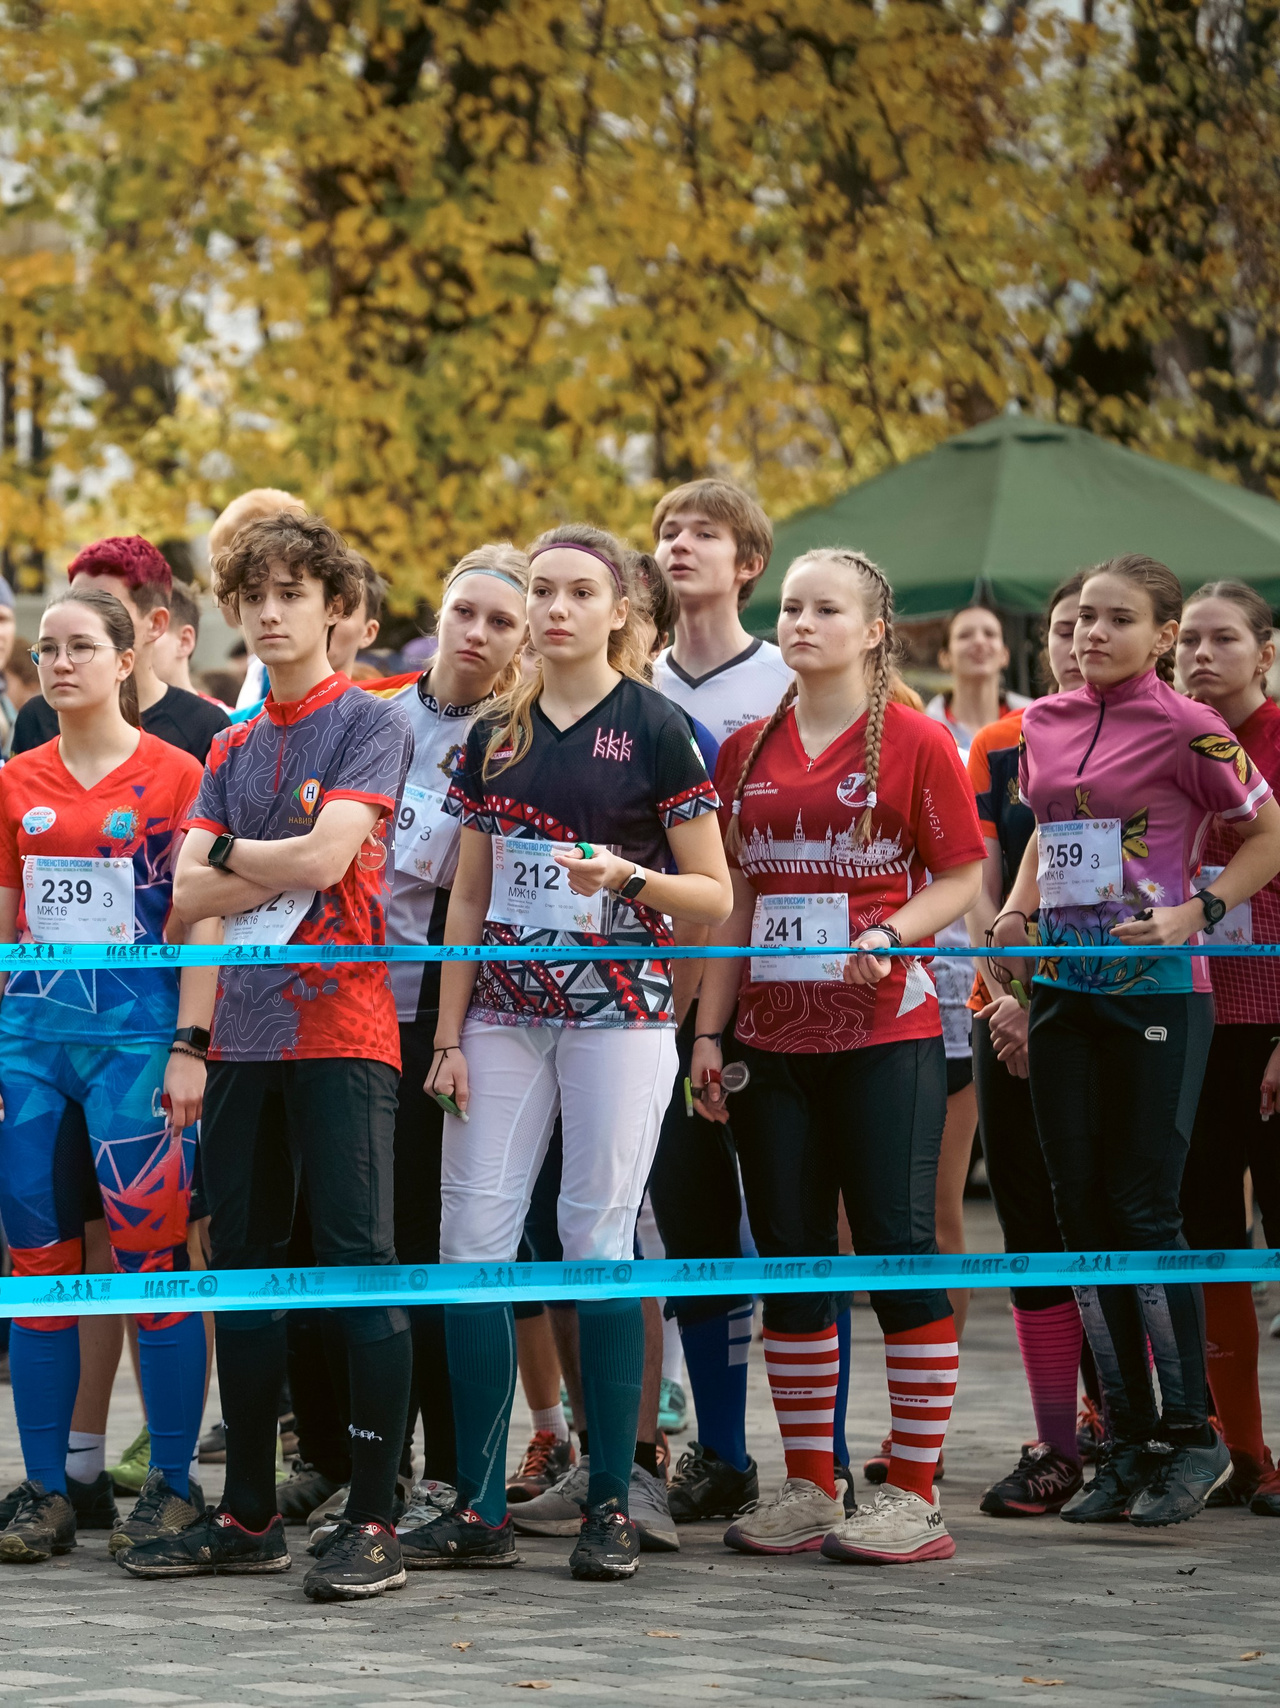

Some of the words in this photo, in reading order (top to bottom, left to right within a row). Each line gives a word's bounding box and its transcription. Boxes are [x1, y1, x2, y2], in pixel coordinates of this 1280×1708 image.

[420, 825, 432, 841] 3
[1064, 822, 1084, 831] РОССИИ
[506, 840, 539, 852] ПЕРВЕНСТВО
[36, 858, 69, 868] ПЕРВЕНСТВО
[69, 859, 93, 868] РОССИИ
[1046, 842, 1083, 869] 259
[1090, 853, 1100, 869] 3
[513, 861, 561, 890] 212
[41, 878, 92, 904] 239
[508, 886, 537, 901] МЖ16
[102, 892, 114, 908] 3
[284, 899, 295, 915] 3
[784, 896, 806, 905] РОССИИ
[36, 904, 68, 916] МЖ16
[234, 914, 259, 927] МЖ16
[763, 916, 802, 942] 241
[816, 928, 828, 945] 3
